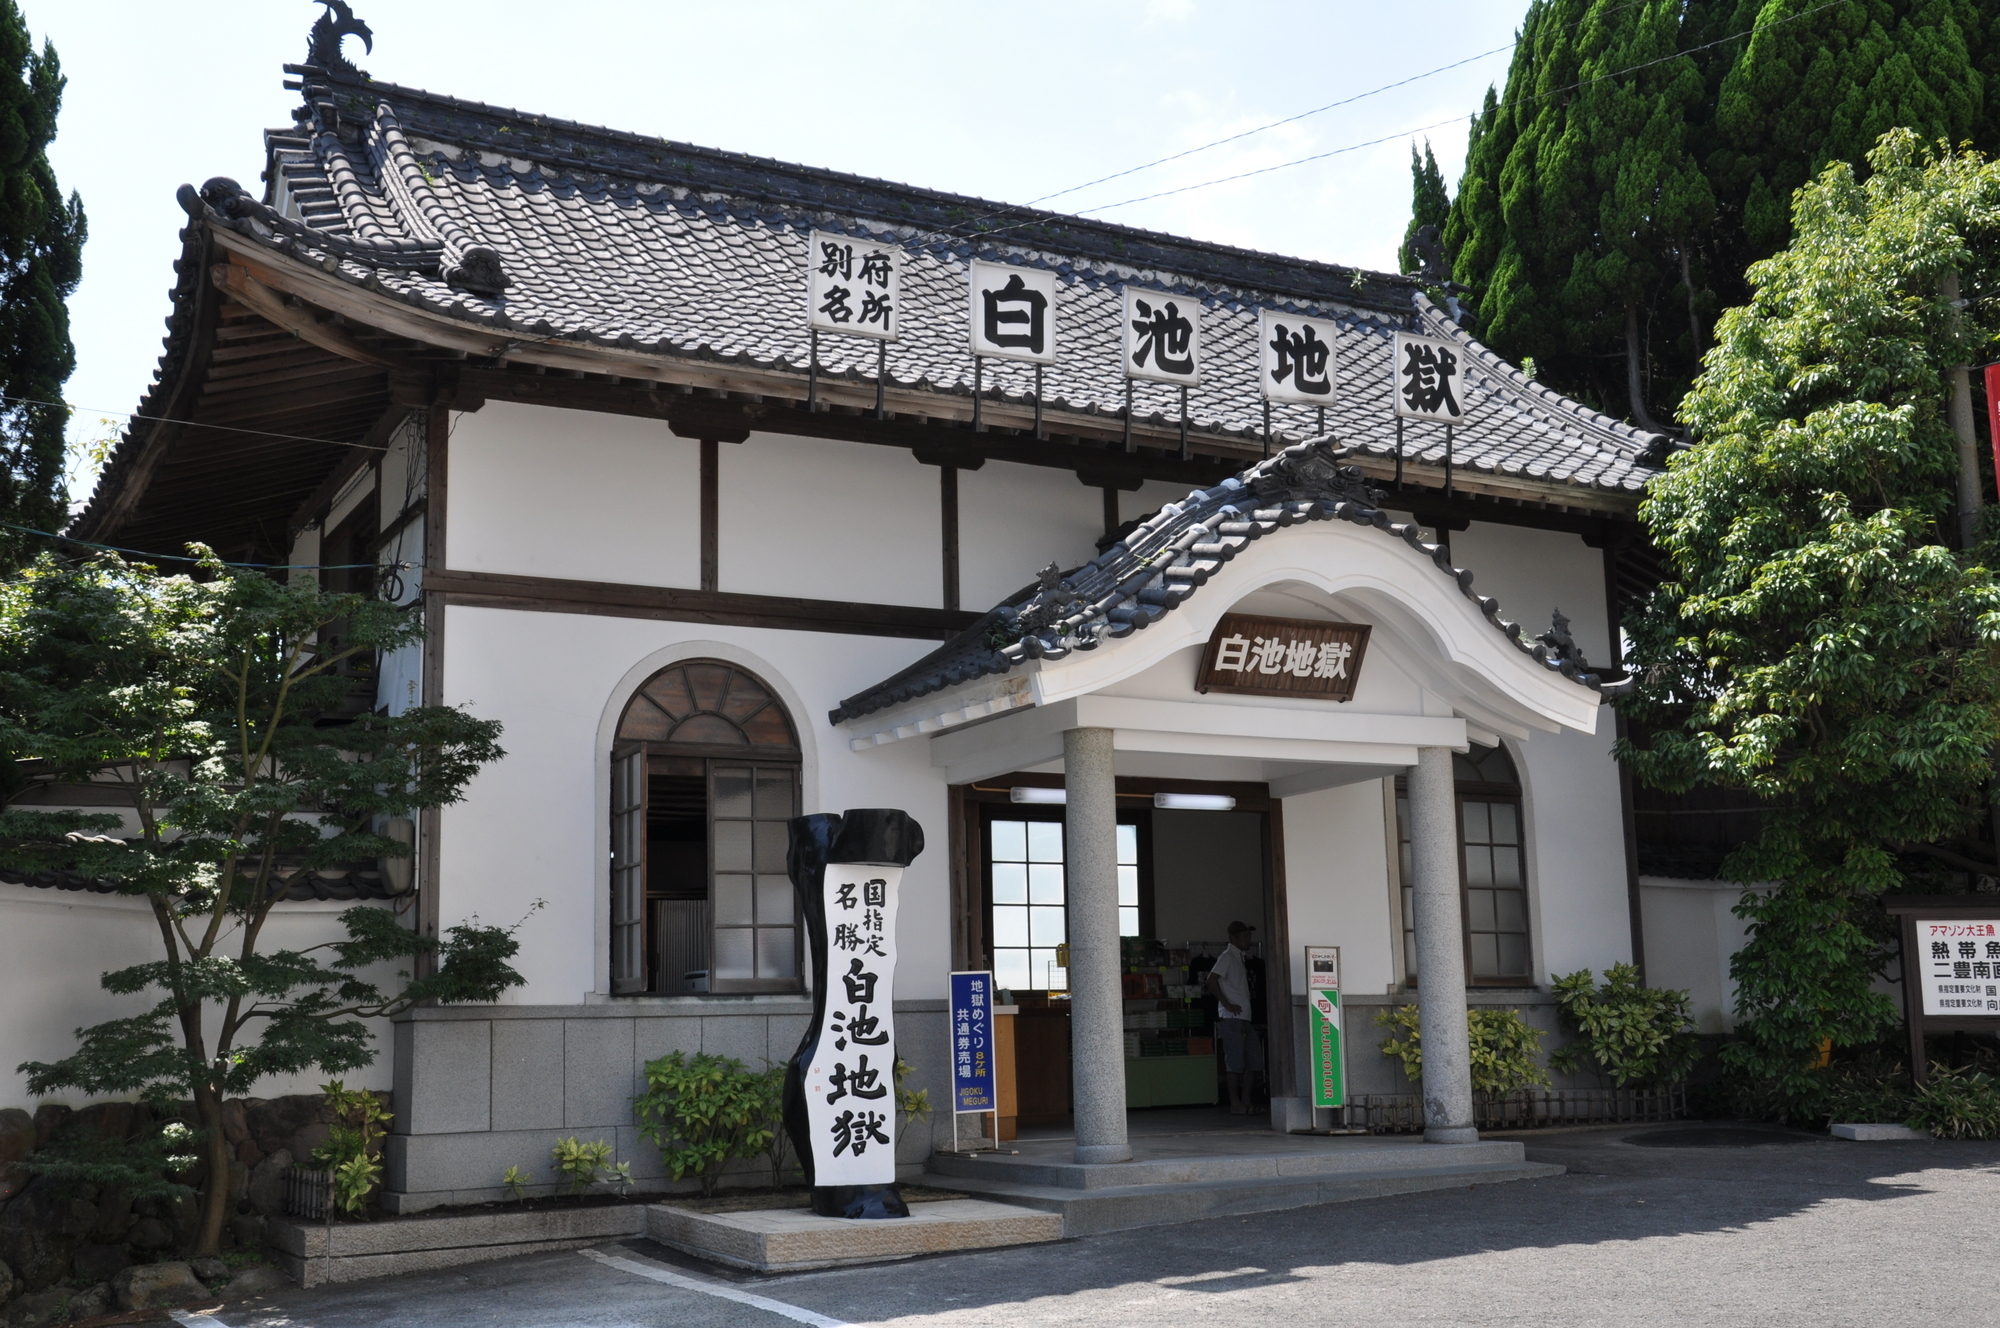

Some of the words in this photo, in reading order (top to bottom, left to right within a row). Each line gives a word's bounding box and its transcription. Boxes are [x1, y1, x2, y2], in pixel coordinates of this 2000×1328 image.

[820, 240, 892, 286] 別府
[819, 284, 892, 332] 名所
[1214, 633, 1352, 680] 白池地獄
[833, 883, 865, 951] 名勝
[863, 878, 887, 958] 国指定
[827, 958, 890, 1158] 白池地獄
[957, 1008, 972, 1078] 共通券売場
[1321, 1017, 1333, 1099] FUJICOLOR
[959, 1087, 983, 1096] JIGOKU
[963, 1096, 988, 1106] MEGURI
